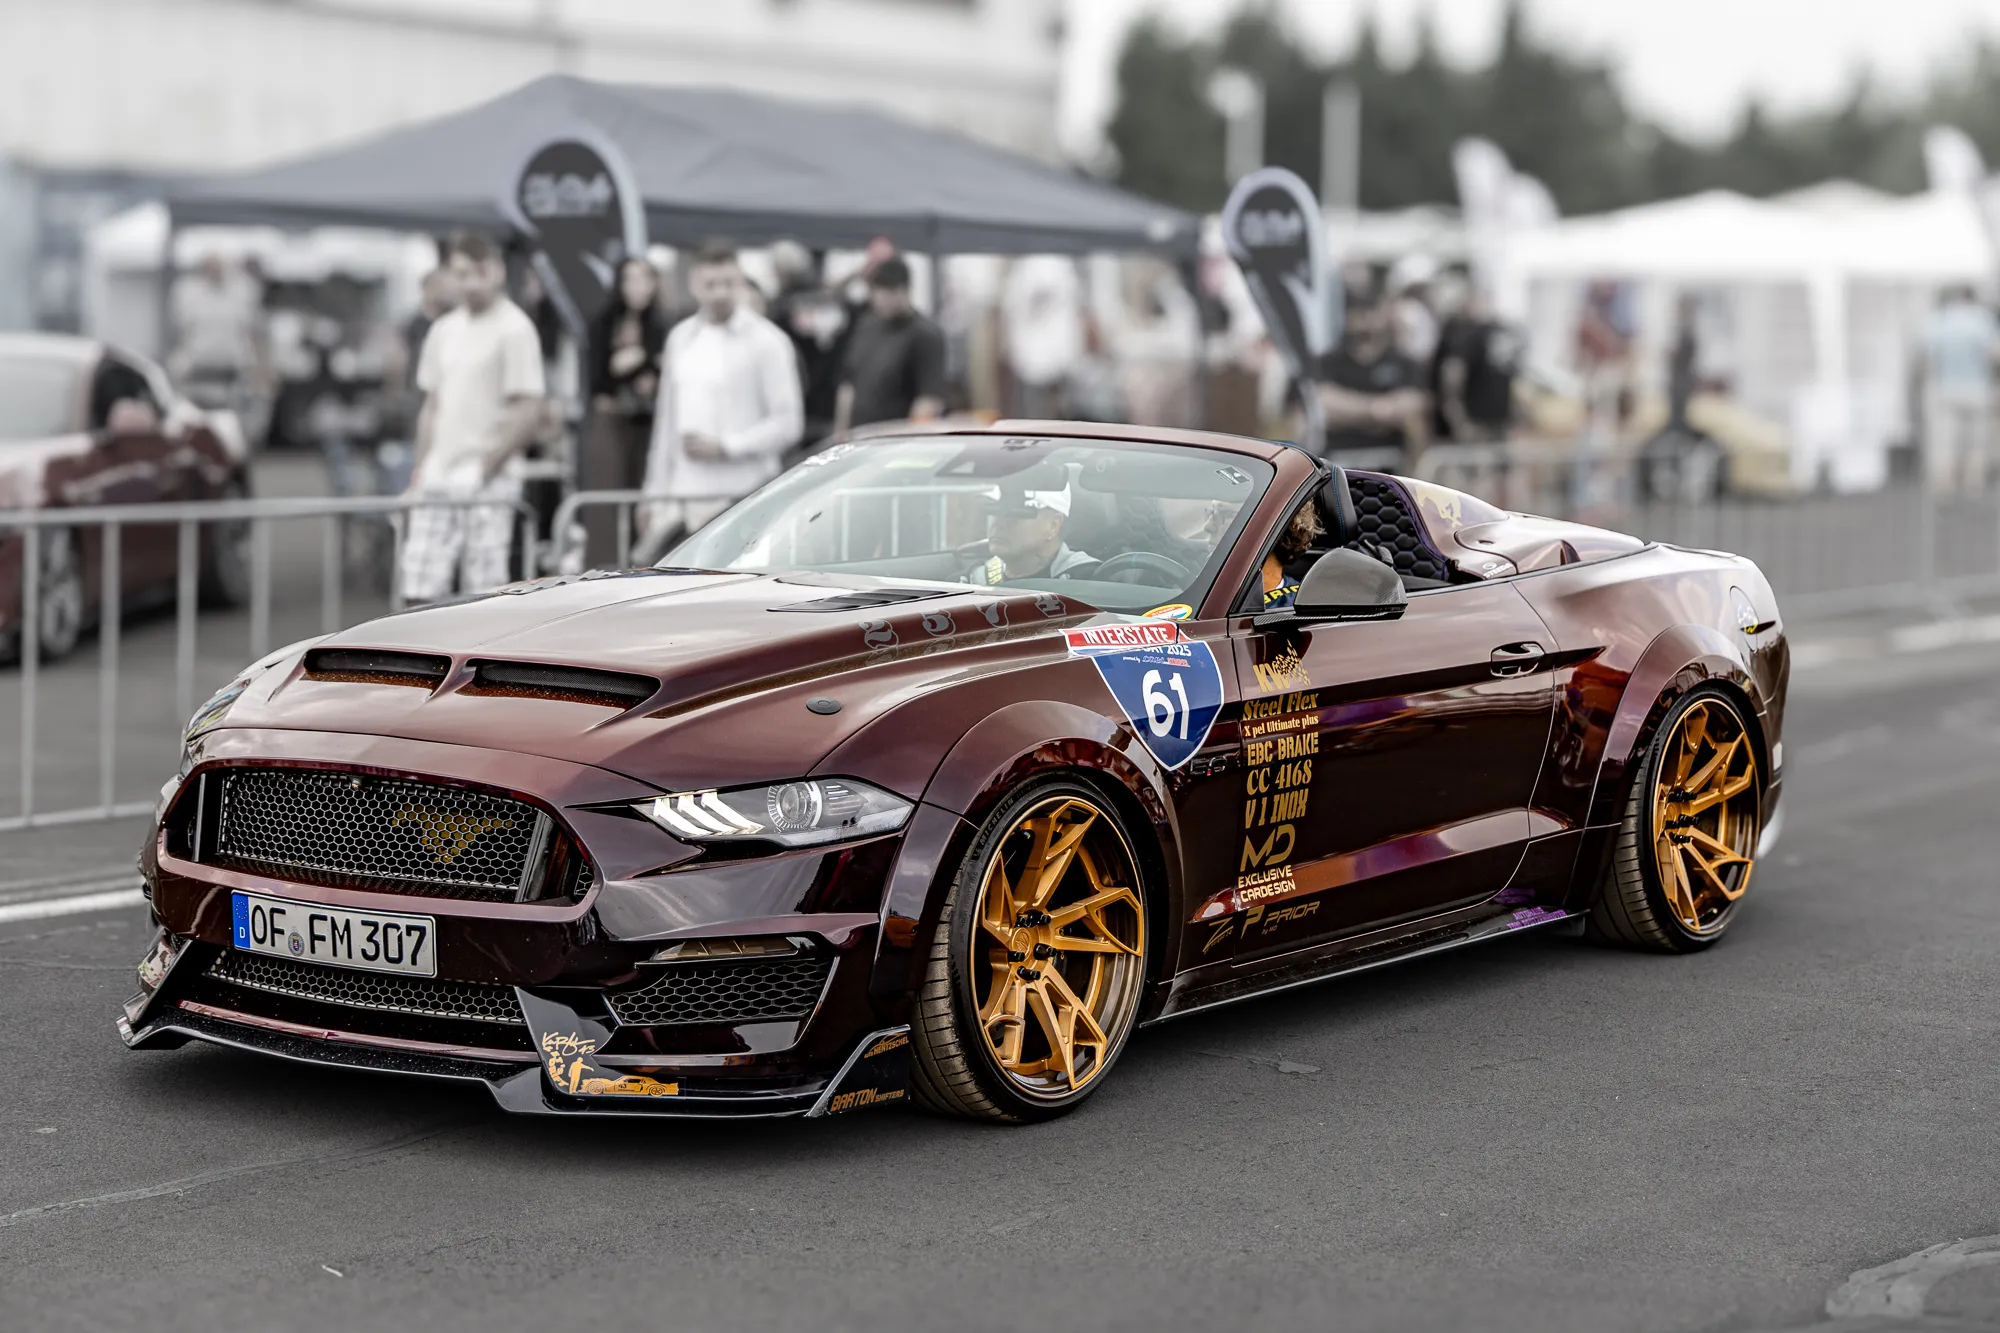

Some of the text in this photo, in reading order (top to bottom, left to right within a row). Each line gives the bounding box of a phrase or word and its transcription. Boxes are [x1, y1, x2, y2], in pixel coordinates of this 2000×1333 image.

[1081, 626, 1169, 645] INTERSTATE
[1166, 644, 1192, 657] 2025
[1252, 660, 1291, 693] KW
[1142, 669, 1190, 740] 61
[1242, 691, 1320, 721] Steel Flex
[1243, 714, 1320, 738] X pel Ultimate plus
[1247, 731, 1320, 766] EBC BRAKE
[1246, 759, 1313, 796] CC 4168
[1269, 788, 1309, 824] INOX
[980, 797, 1015, 847] MICHELIN
[1239, 823, 1296, 873] MD
[1237, 865, 1293, 889] EXCLUSIVE
[1240, 879, 1297, 903] CARDESIGN
[1264, 900, 1321, 927] PRIOR
[239, 926, 246, 939] D
[251, 904, 427, 967] OF FM 307
[830, 1087, 905, 1112] BARTON SHIFTERS
